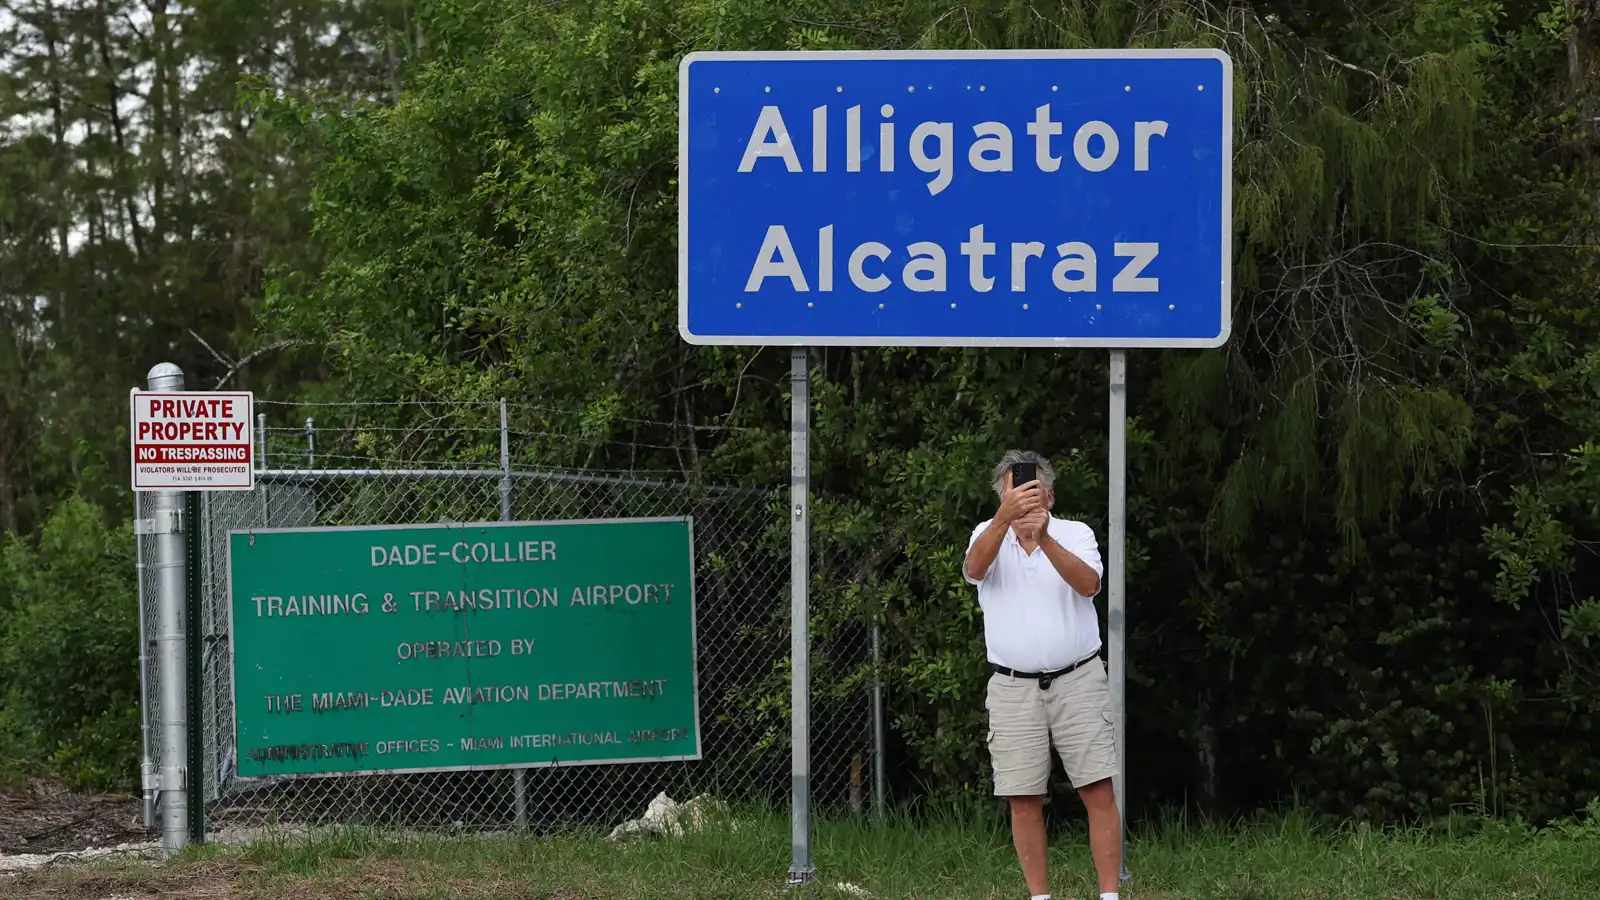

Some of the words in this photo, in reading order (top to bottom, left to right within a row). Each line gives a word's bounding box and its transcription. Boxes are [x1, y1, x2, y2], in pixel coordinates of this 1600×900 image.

[736, 103, 1169, 196] Alligator
[743, 223, 1160, 293] Alcatraz
[150, 400, 233, 418] PRIVATE
[139, 422, 245, 440] PROPERTY
[139, 448, 157, 460] NO
[160, 448, 246, 460] TRESPASSING
[370, 540, 557, 567] DADE-COLLIER
[251, 593, 369, 617] TRAINING
[381, 592, 396, 613] &
[409, 587, 558, 612] TRANSITION
[570, 583, 674, 607] AIRPORT
[397, 639, 501, 660] OPERATED
[511, 638, 535, 655] BY
[264, 694, 303, 713] THE
[311, 688, 434, 711] MIAMI-DADE
[442, 685, 529, 705] AVIATION
[538, 679, 667, 701] DEPARTMENT
[376, 739, 440, 755] OFFICES
[461, 735, 504, 751] MIAMI
[510, 731, 622, 749] INTERNATIONAL
[628, 728, 689, 744] AIRPORT
